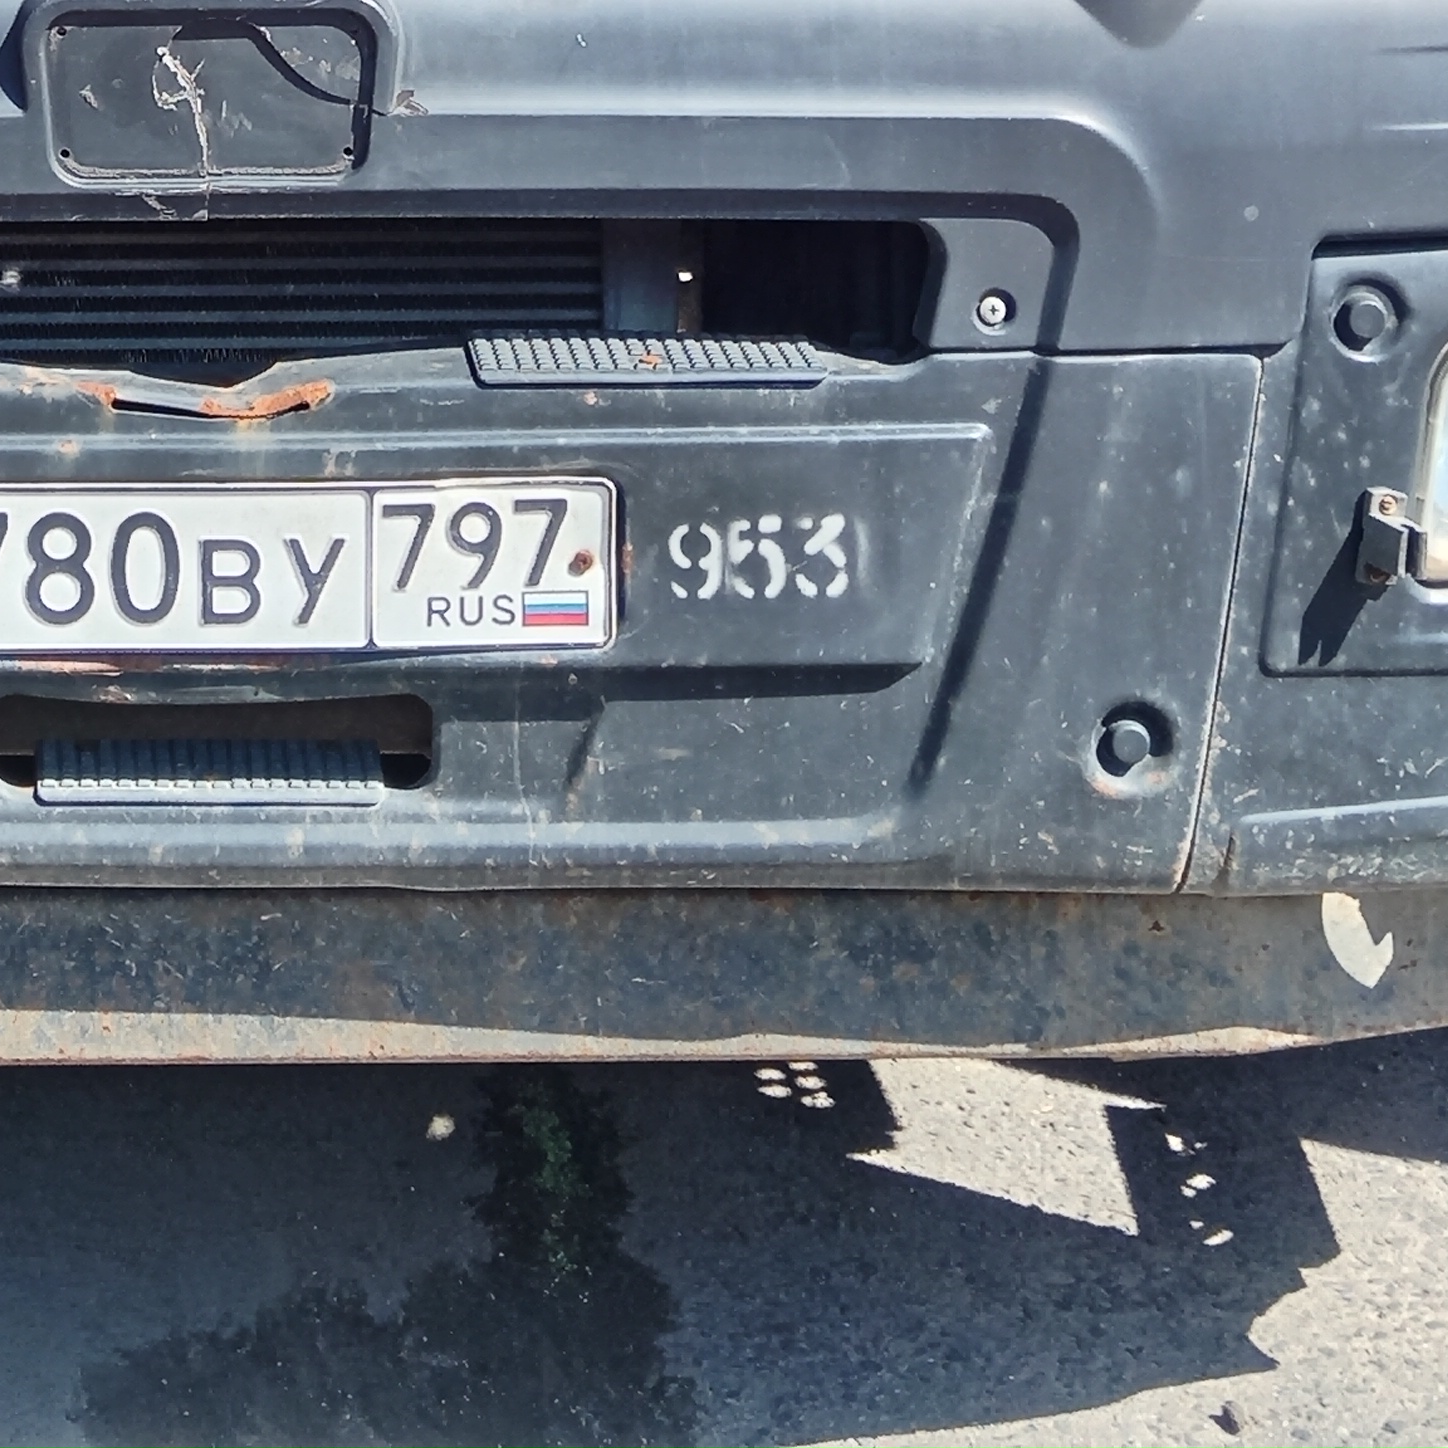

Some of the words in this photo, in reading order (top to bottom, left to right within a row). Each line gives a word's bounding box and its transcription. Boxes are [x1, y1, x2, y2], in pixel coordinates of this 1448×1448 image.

[381, 498, 569, 593] 797
[667, 514, 850, 600] 953
[425, 595, 515, 628] RUS
